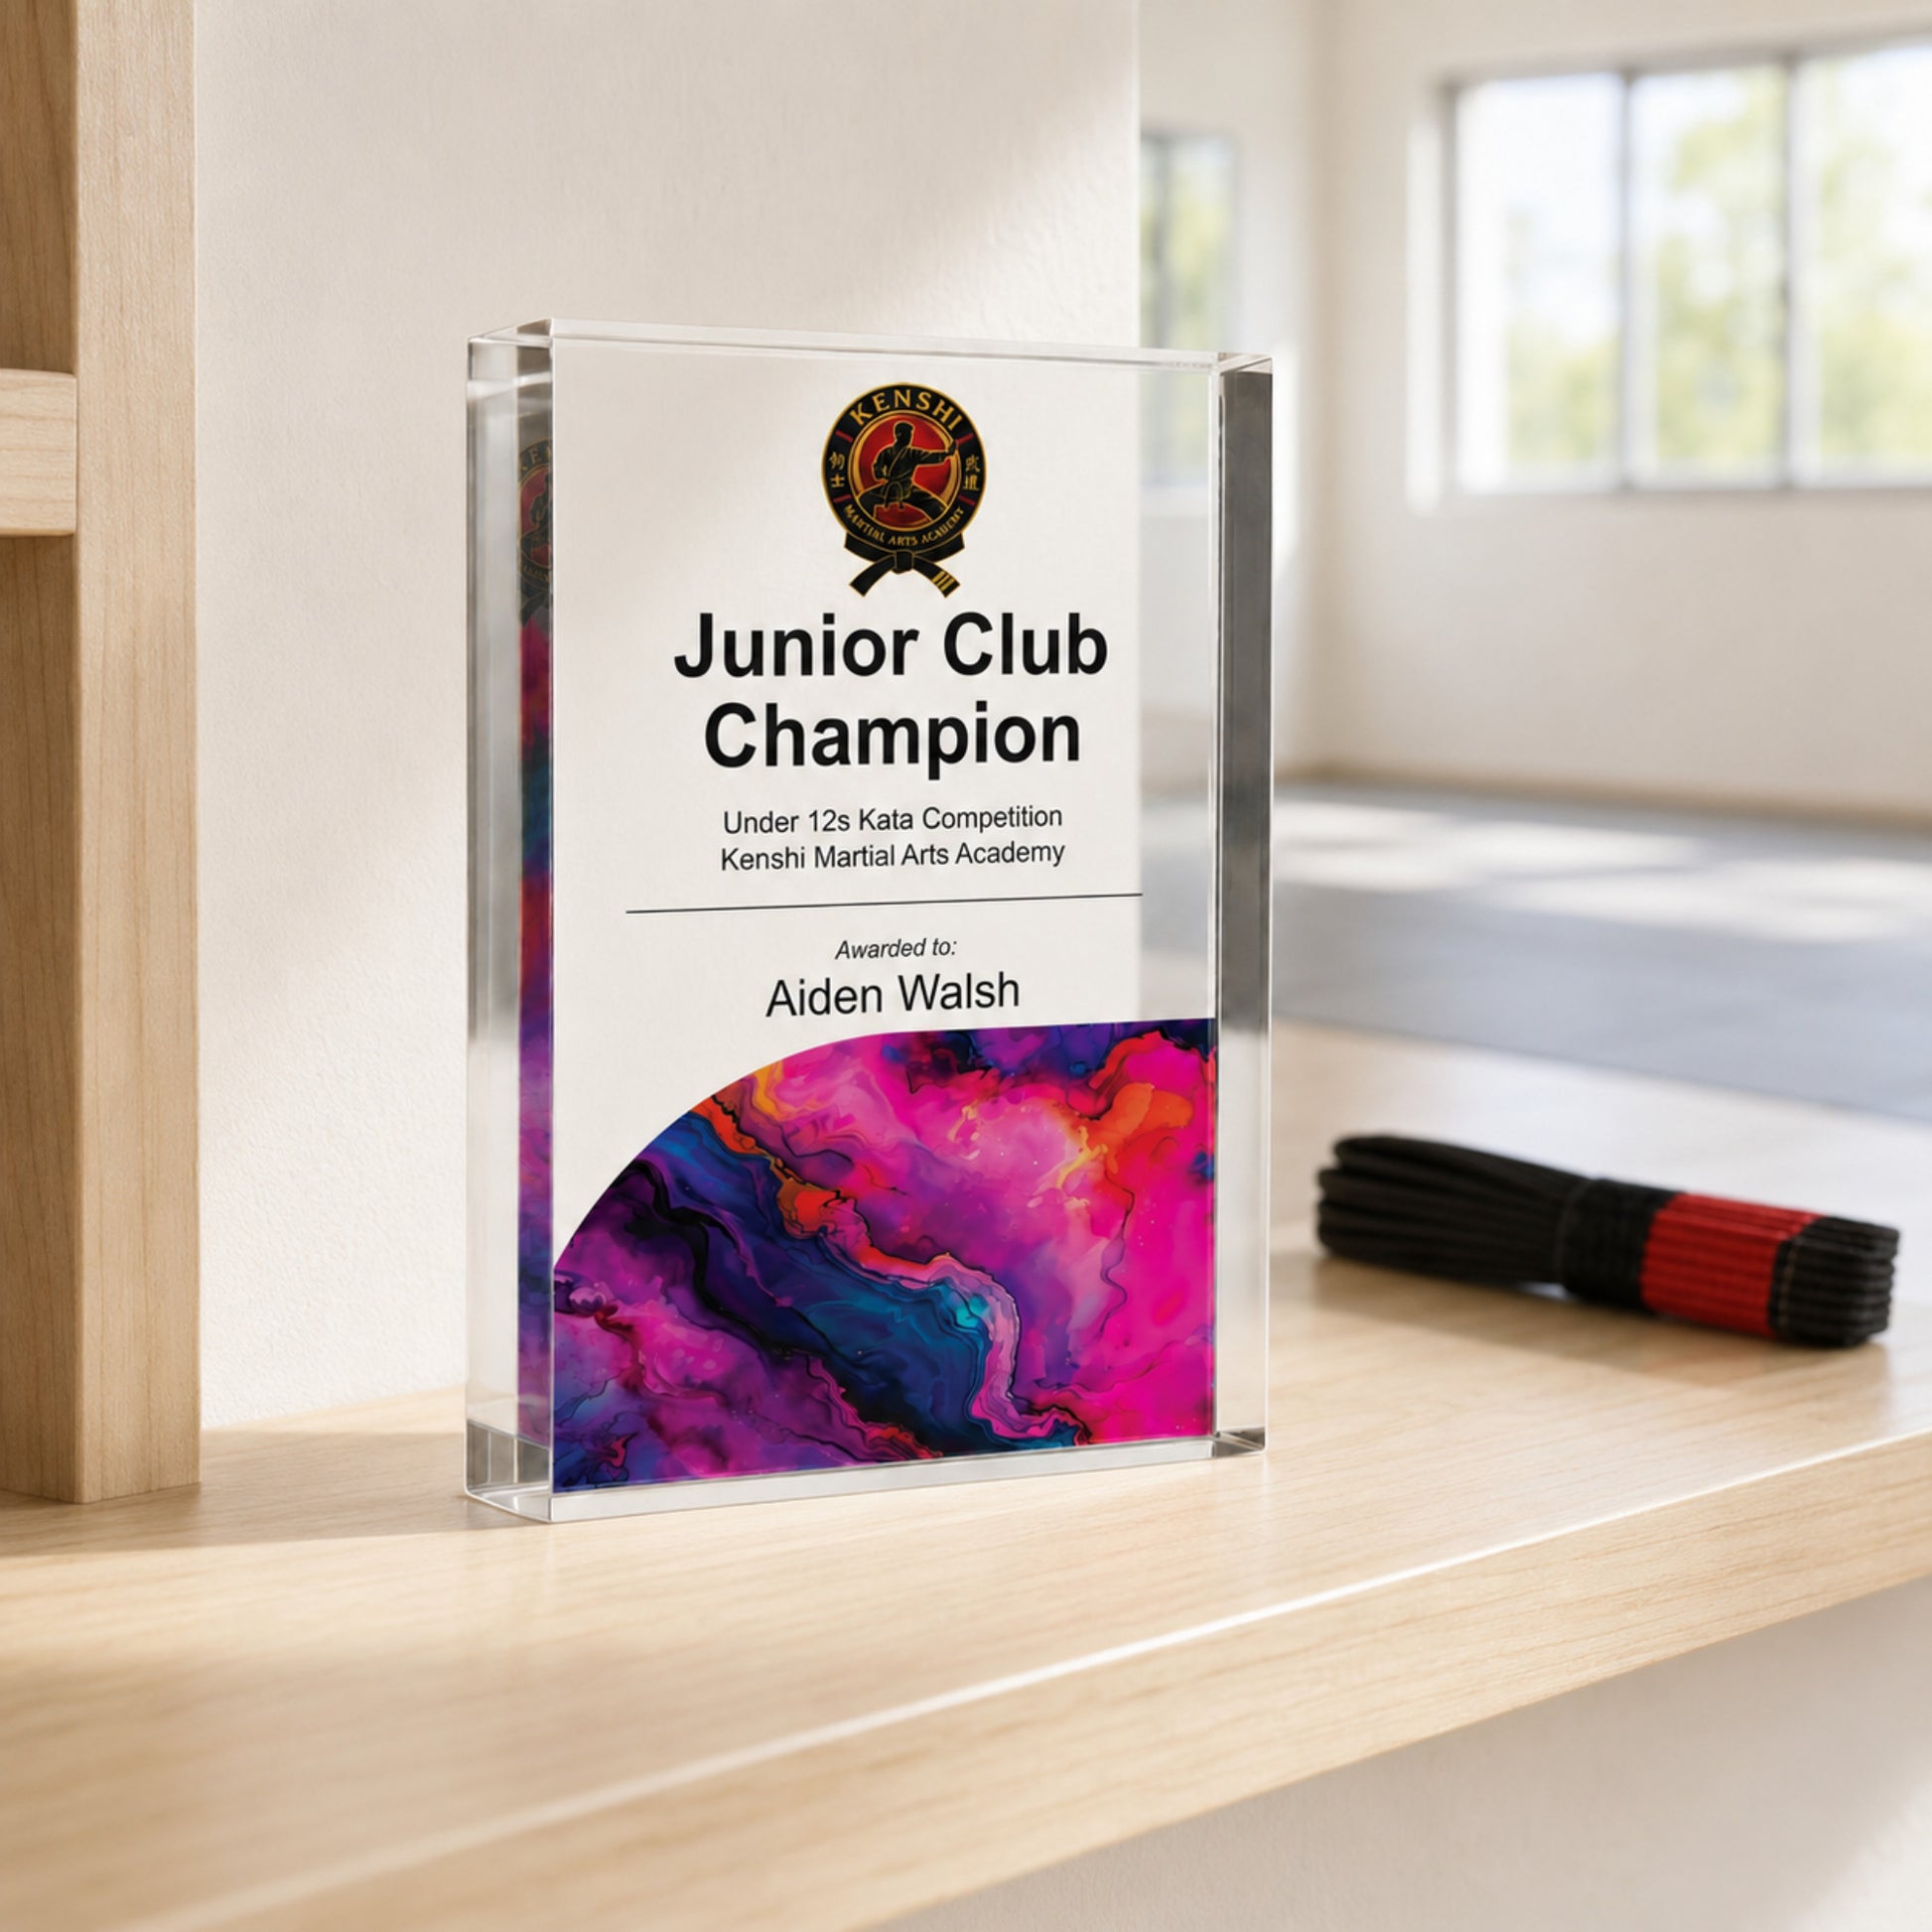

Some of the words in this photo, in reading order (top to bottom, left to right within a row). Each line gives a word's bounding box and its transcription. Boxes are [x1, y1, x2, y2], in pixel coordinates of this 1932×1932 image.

[851, 390, 962, 430] KENSHI
[888, 534, 918, 547] ARTS
[674, 613, 919, 678] Junior
[944, 612, 1107, 676] Club
[705, 700, 1079, 780] Champion
[725, 811, 799, 834] Under
[809, 809, 850, 832] 12s
[860, 808, 912, 830] Kata
[922, 805, 1061, 833] Competition
[722, 847, 804, 871] Kenshi
[815, 845, 895, 868] Martial
[901, 844, 949, 866] Arts
[955, 841, 1065, 867] Academy
[835, 938, 926, 959] Awarded
[932, 938, 956, 955] to:
[765, 978, 882, 1017] Aiden
[897, 971, 1019, 1011] Walsh
